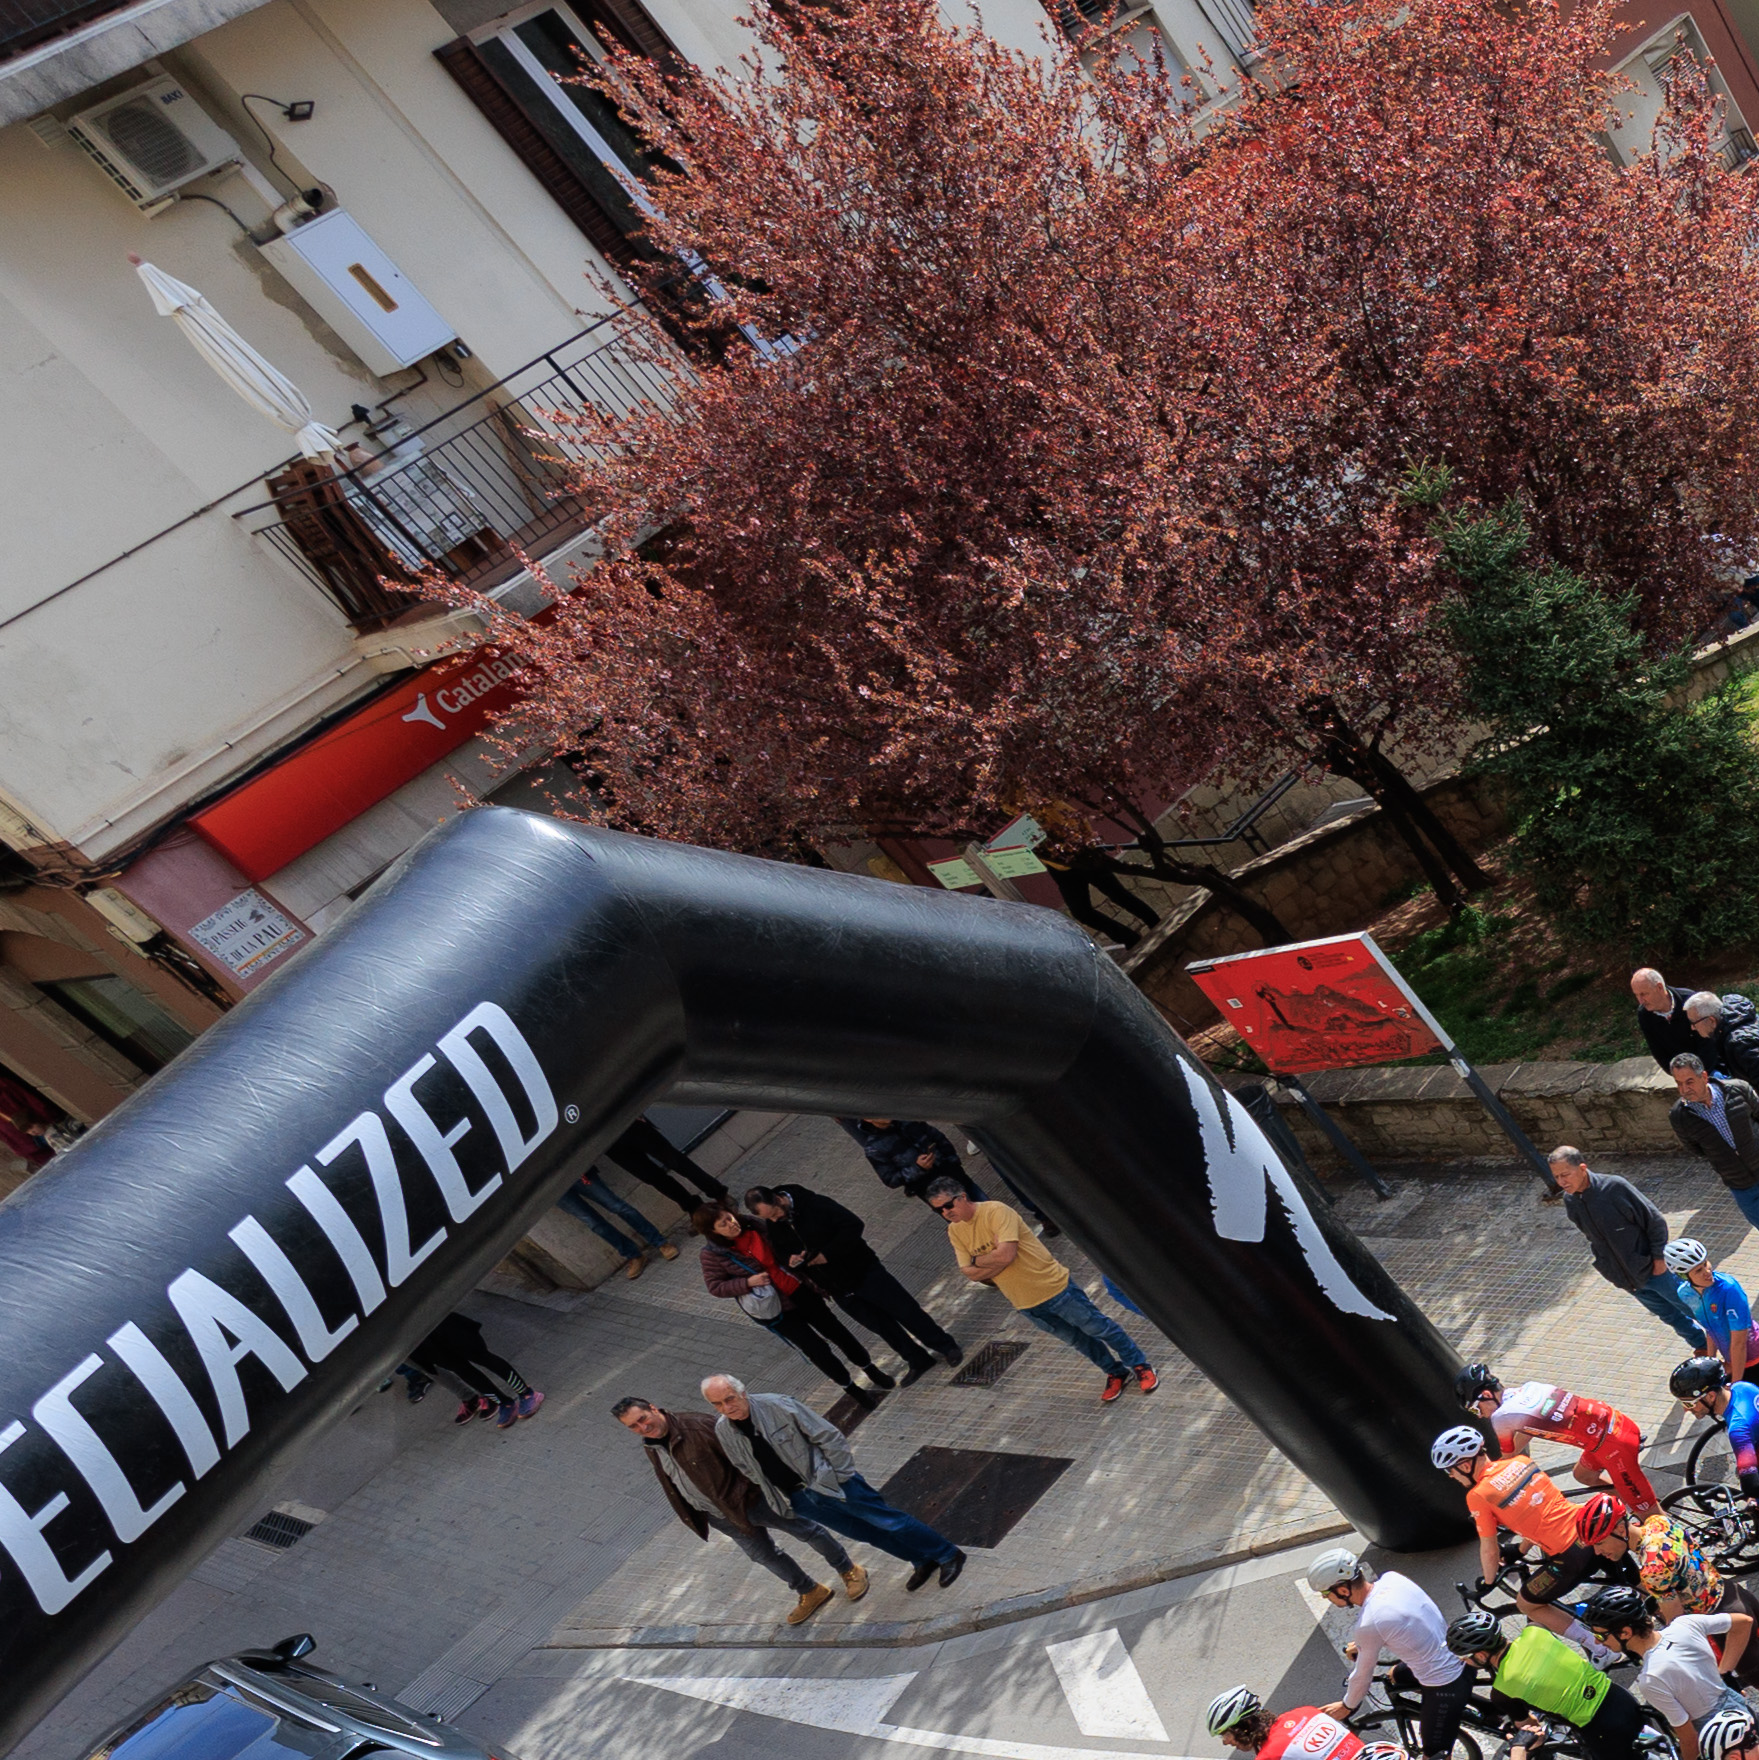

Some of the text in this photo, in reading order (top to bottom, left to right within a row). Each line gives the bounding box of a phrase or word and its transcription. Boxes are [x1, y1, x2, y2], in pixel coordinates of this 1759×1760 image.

[436, 650, 531, 713] Catalan
[211, 918, 247, 946] PASSEIG
[253, 922, 284, 947] PAU
[1308, 1725, 1334, 1748] KIA
